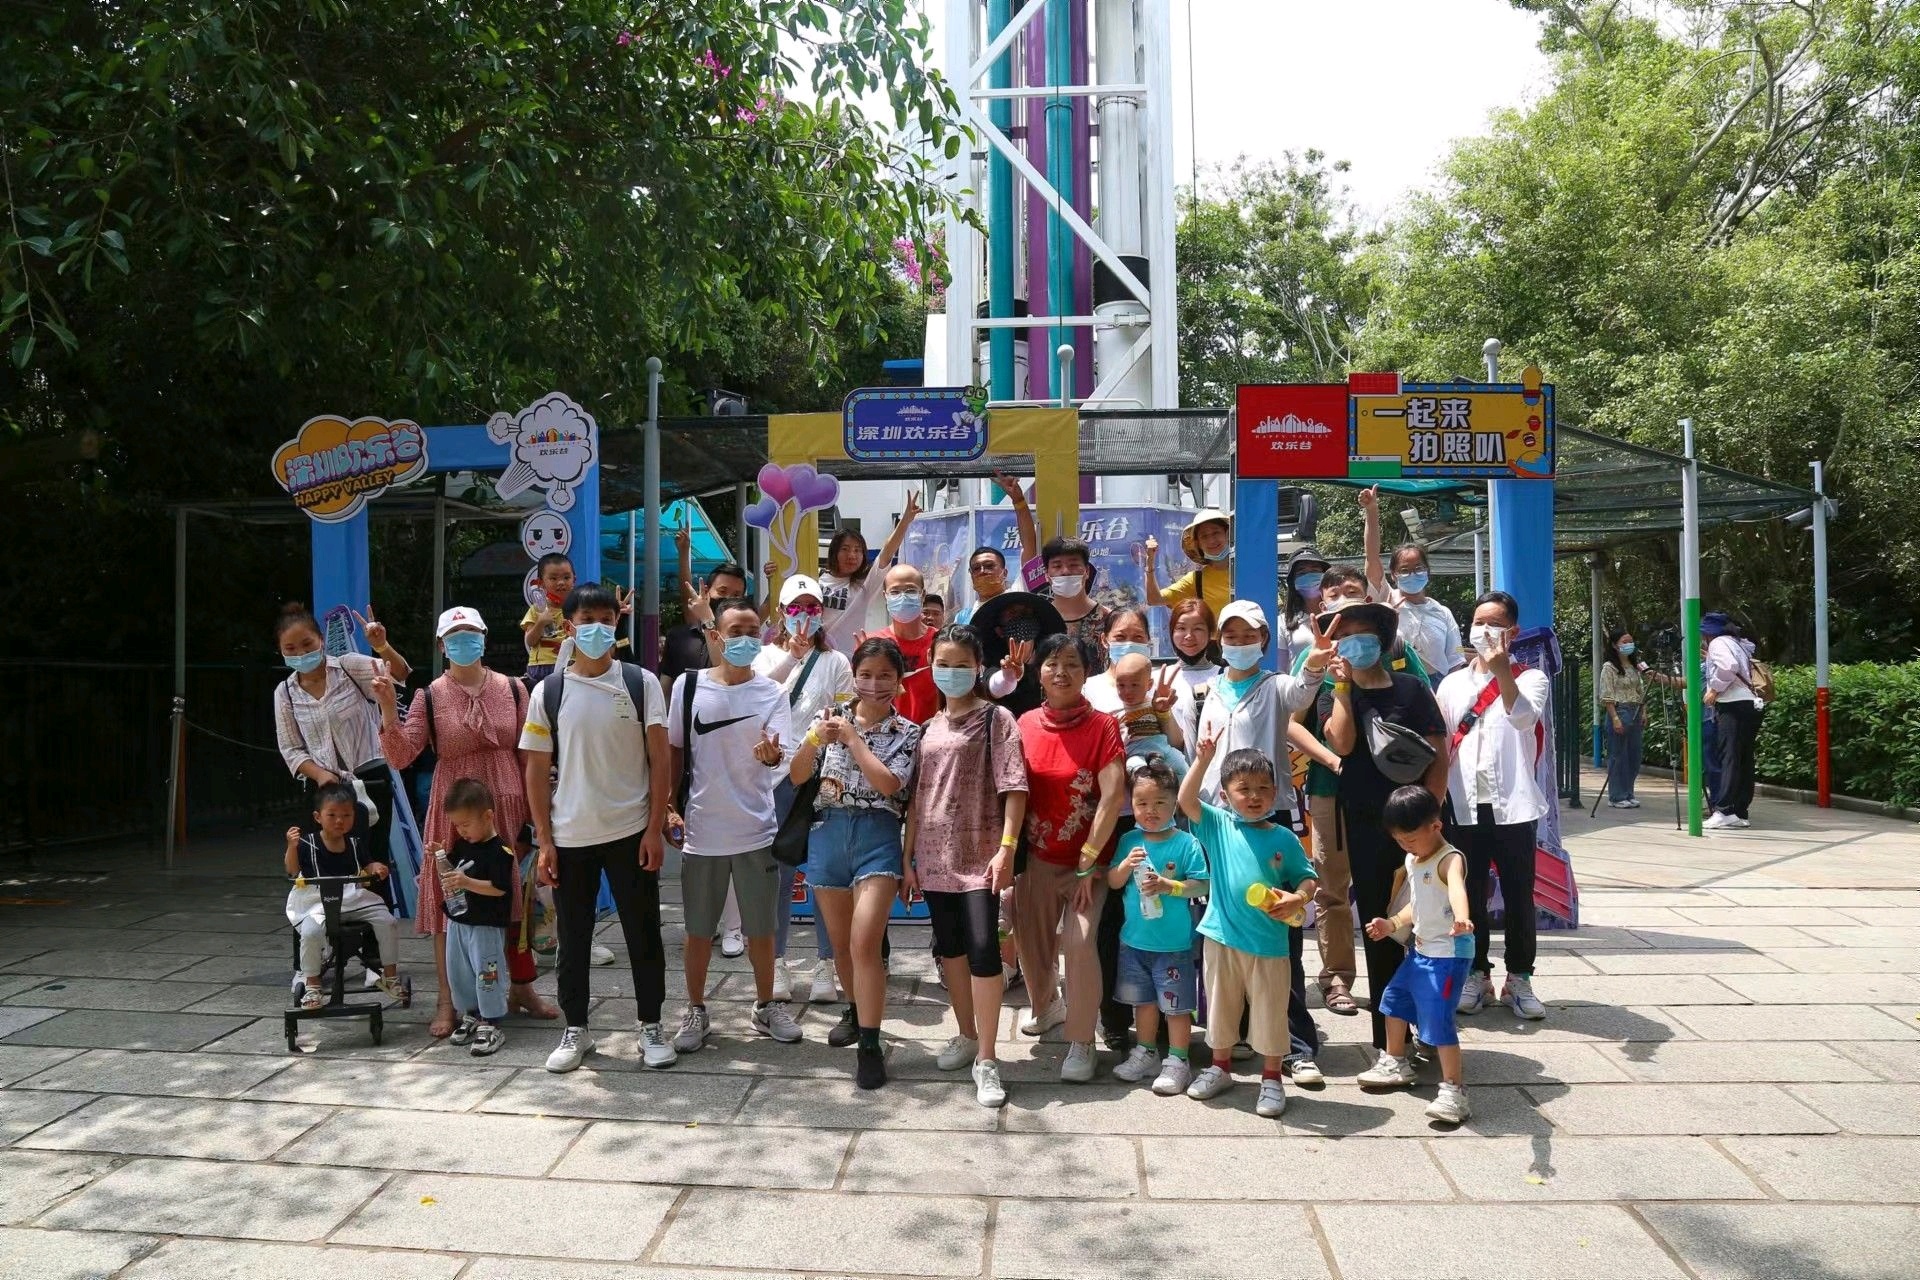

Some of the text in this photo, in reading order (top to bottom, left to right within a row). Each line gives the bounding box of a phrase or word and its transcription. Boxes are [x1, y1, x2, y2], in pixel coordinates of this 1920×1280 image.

[1374, 398, 1470, 429] 一起来
[857, 425, 971, 440] 深圳欢乐谷
[1270, 441, 1312, 450] 欢乐谷
[1410, 432, 1505, 463] 拍照叭
[295, 471, 394, 507] HAPPY VALLEY
[798, 581, 807, 589] R
